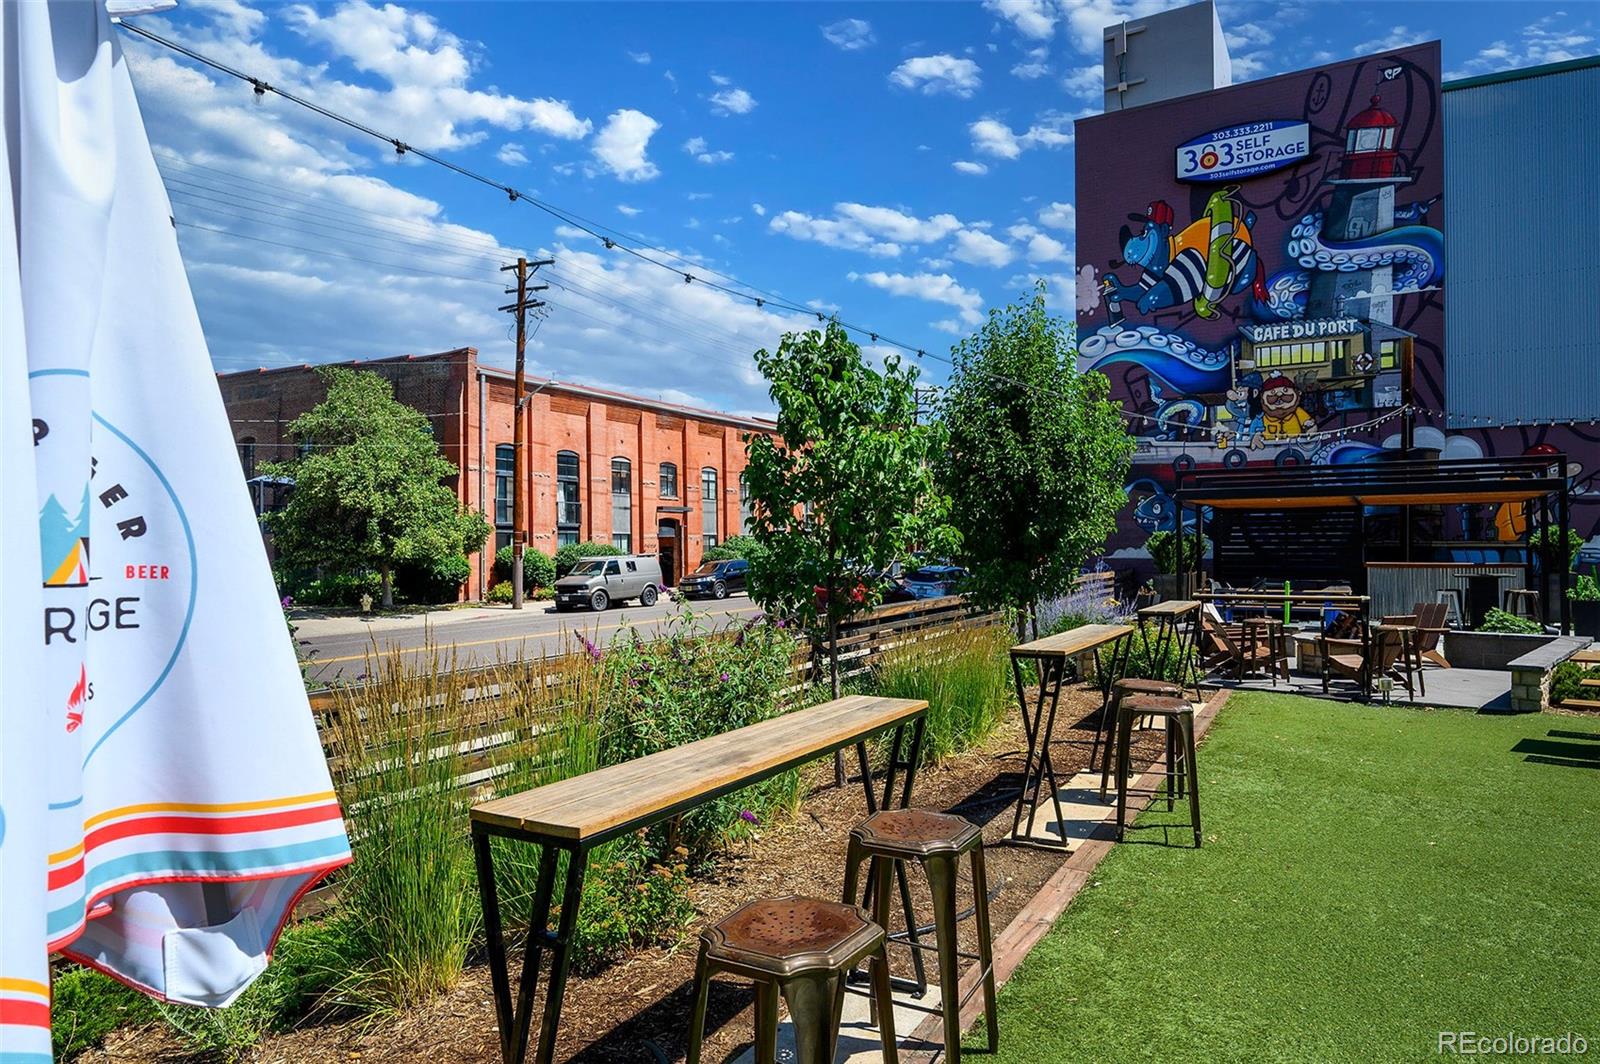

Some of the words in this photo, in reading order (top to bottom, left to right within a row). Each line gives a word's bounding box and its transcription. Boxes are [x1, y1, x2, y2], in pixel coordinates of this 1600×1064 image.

[1212, 122, 1273, 141] 303.333.2211
[1236, 135, 1270, 151] SELF
[1236, 141, 1305, 164] STORAGE
[1209, 163, 1276, 180] 303selfstorage.com
[1253, 325, 1290, 342] CAFE
[1292, 322, 1315, 338] DU
[1318, 319, 1358, 335] PORT
[125, 564, 169, 580] BEER
